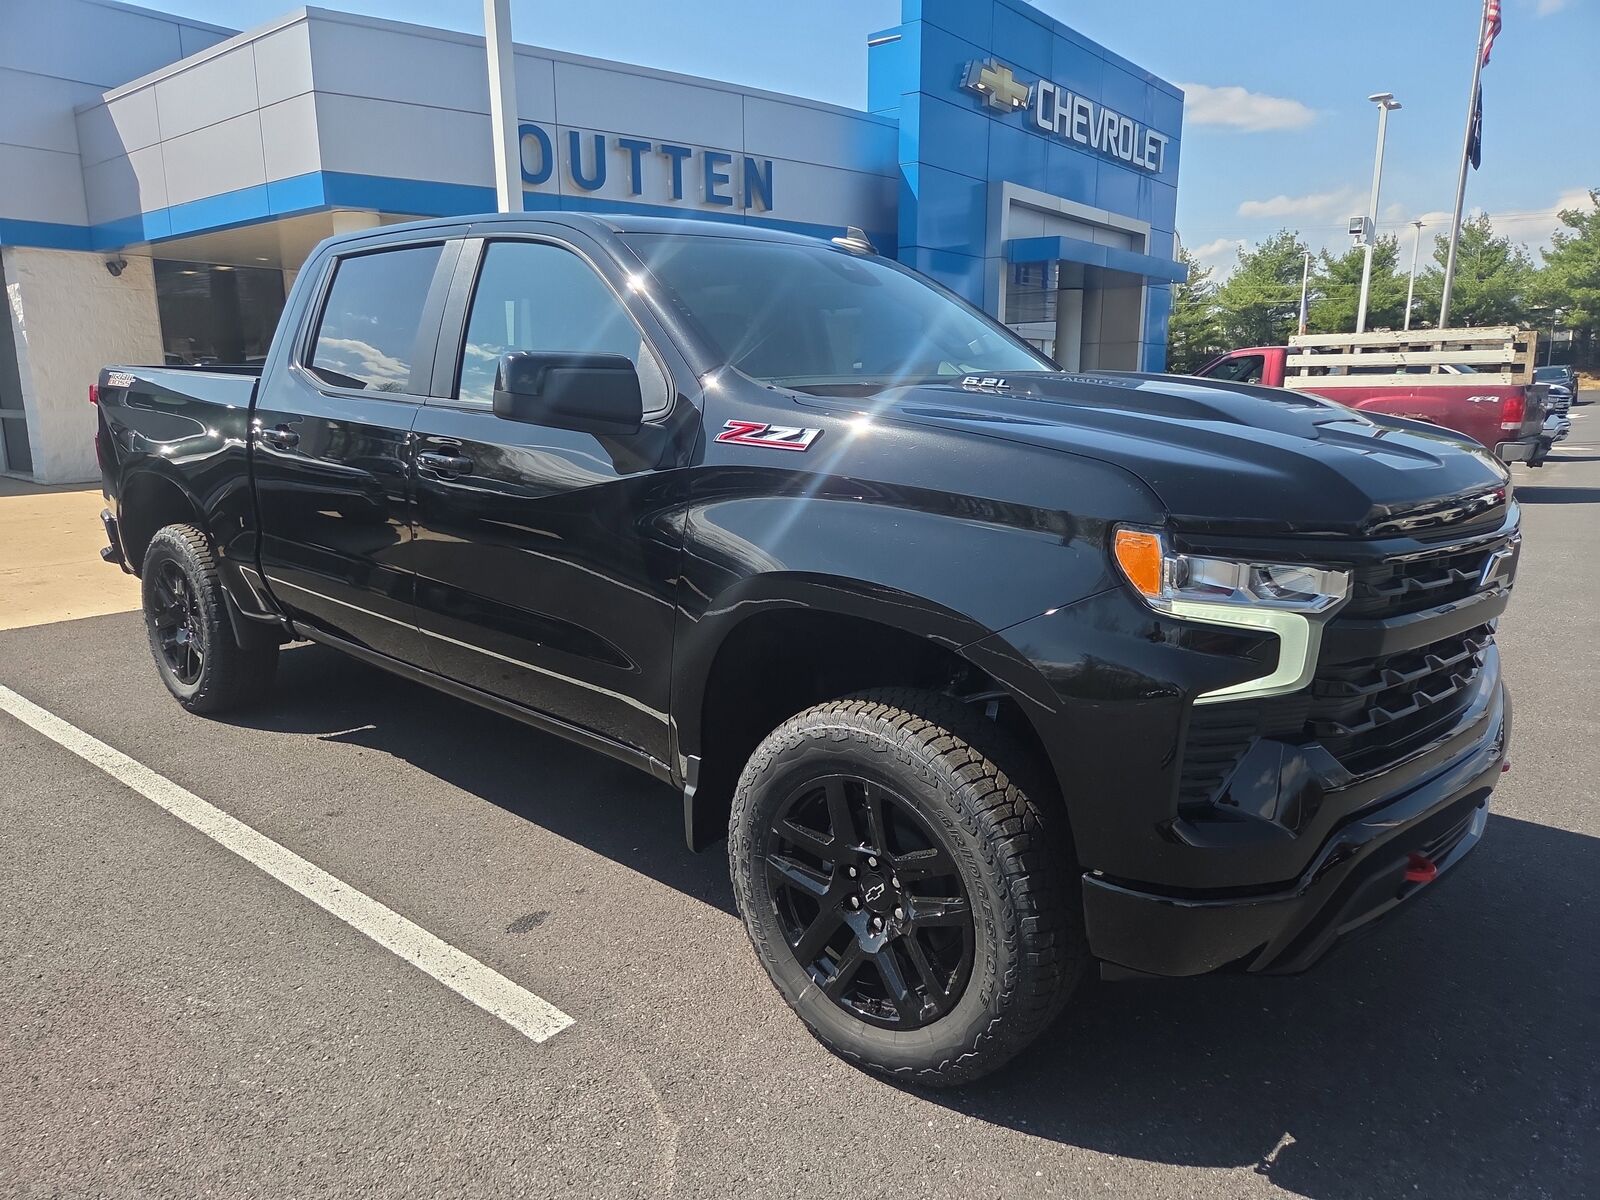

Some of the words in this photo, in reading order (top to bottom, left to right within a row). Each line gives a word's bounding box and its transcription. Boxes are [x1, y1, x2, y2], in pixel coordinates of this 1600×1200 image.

[1036, 79, 1169, 174] CHEVROLET
[518, 123, 773, 211] OUTTEN
[962, 376, 1010, 388] 6.2L
[713, 419, 823, 452] Z71
